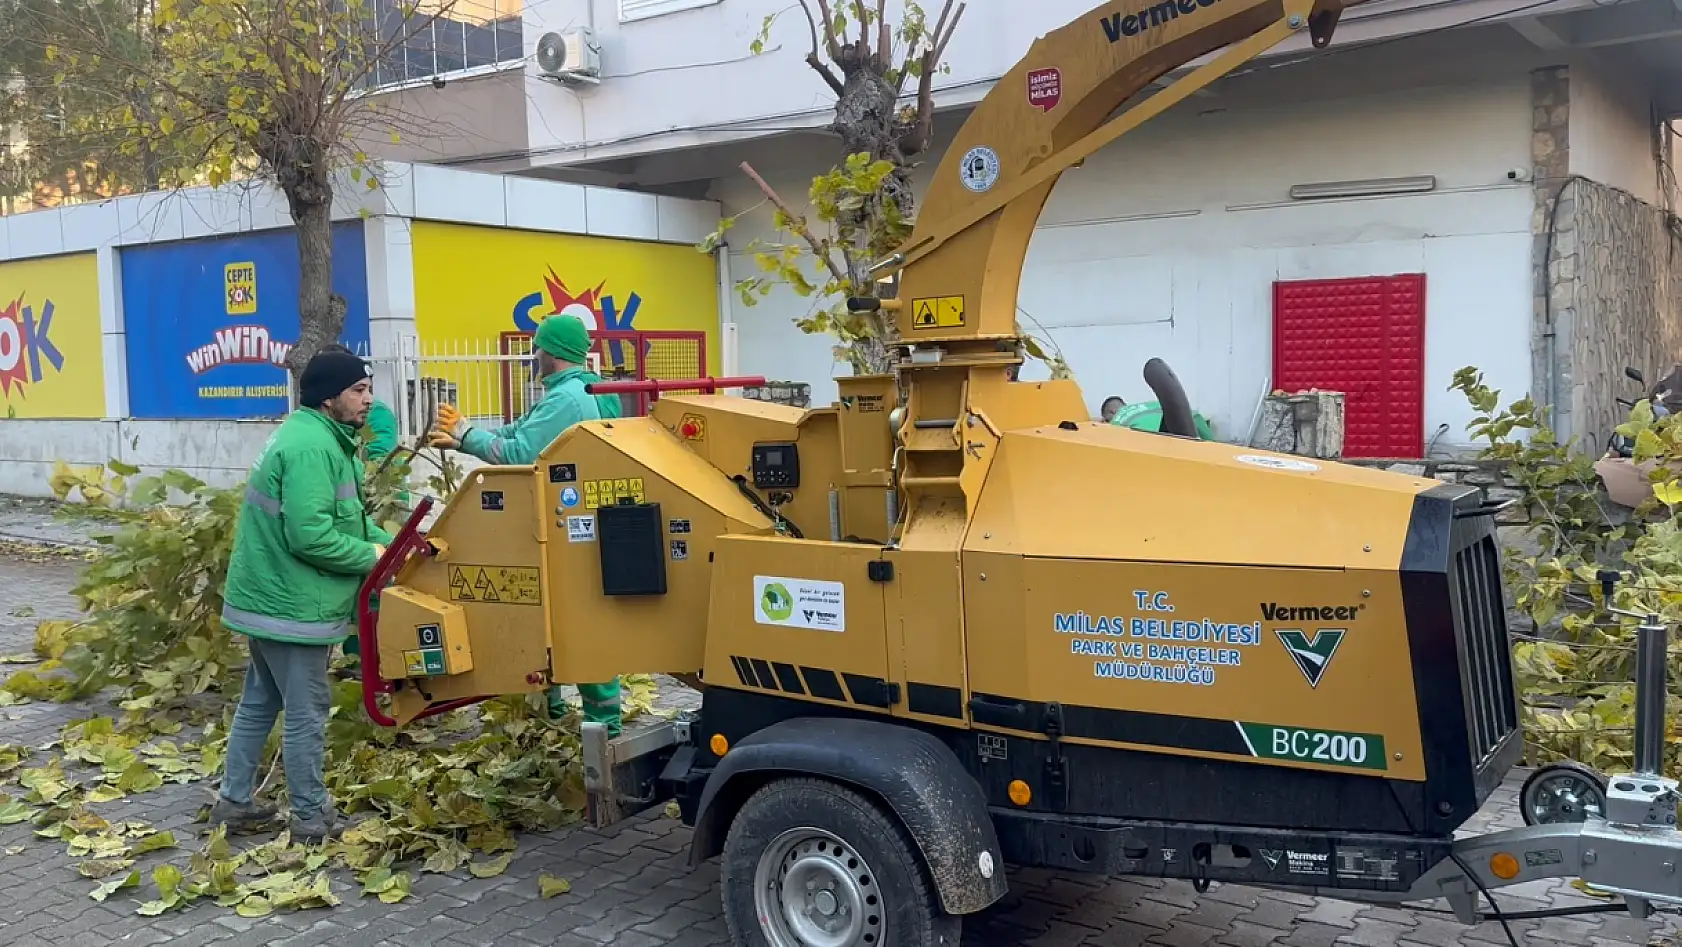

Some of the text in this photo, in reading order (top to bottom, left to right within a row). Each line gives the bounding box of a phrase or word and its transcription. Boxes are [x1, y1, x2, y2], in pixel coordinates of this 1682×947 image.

[1100, 0, 1221, 43] Verme
[227, 267, 253, 283] CEPTE
[0, 298, 65, 383] OK
[1133, 589, 1175, 611] T.C.
[1054, 611, 1262, 645] MİLAS BELEDİYESİ
[1072, 639, 1241, 665] PARK VE BAHÇELER
[1094, 660, 1215, 685] MÜDÜRLÜĞÜ
[1272, 728, 1367, 763] BC200
[1286, 850, 1328, 861] Vermeer
